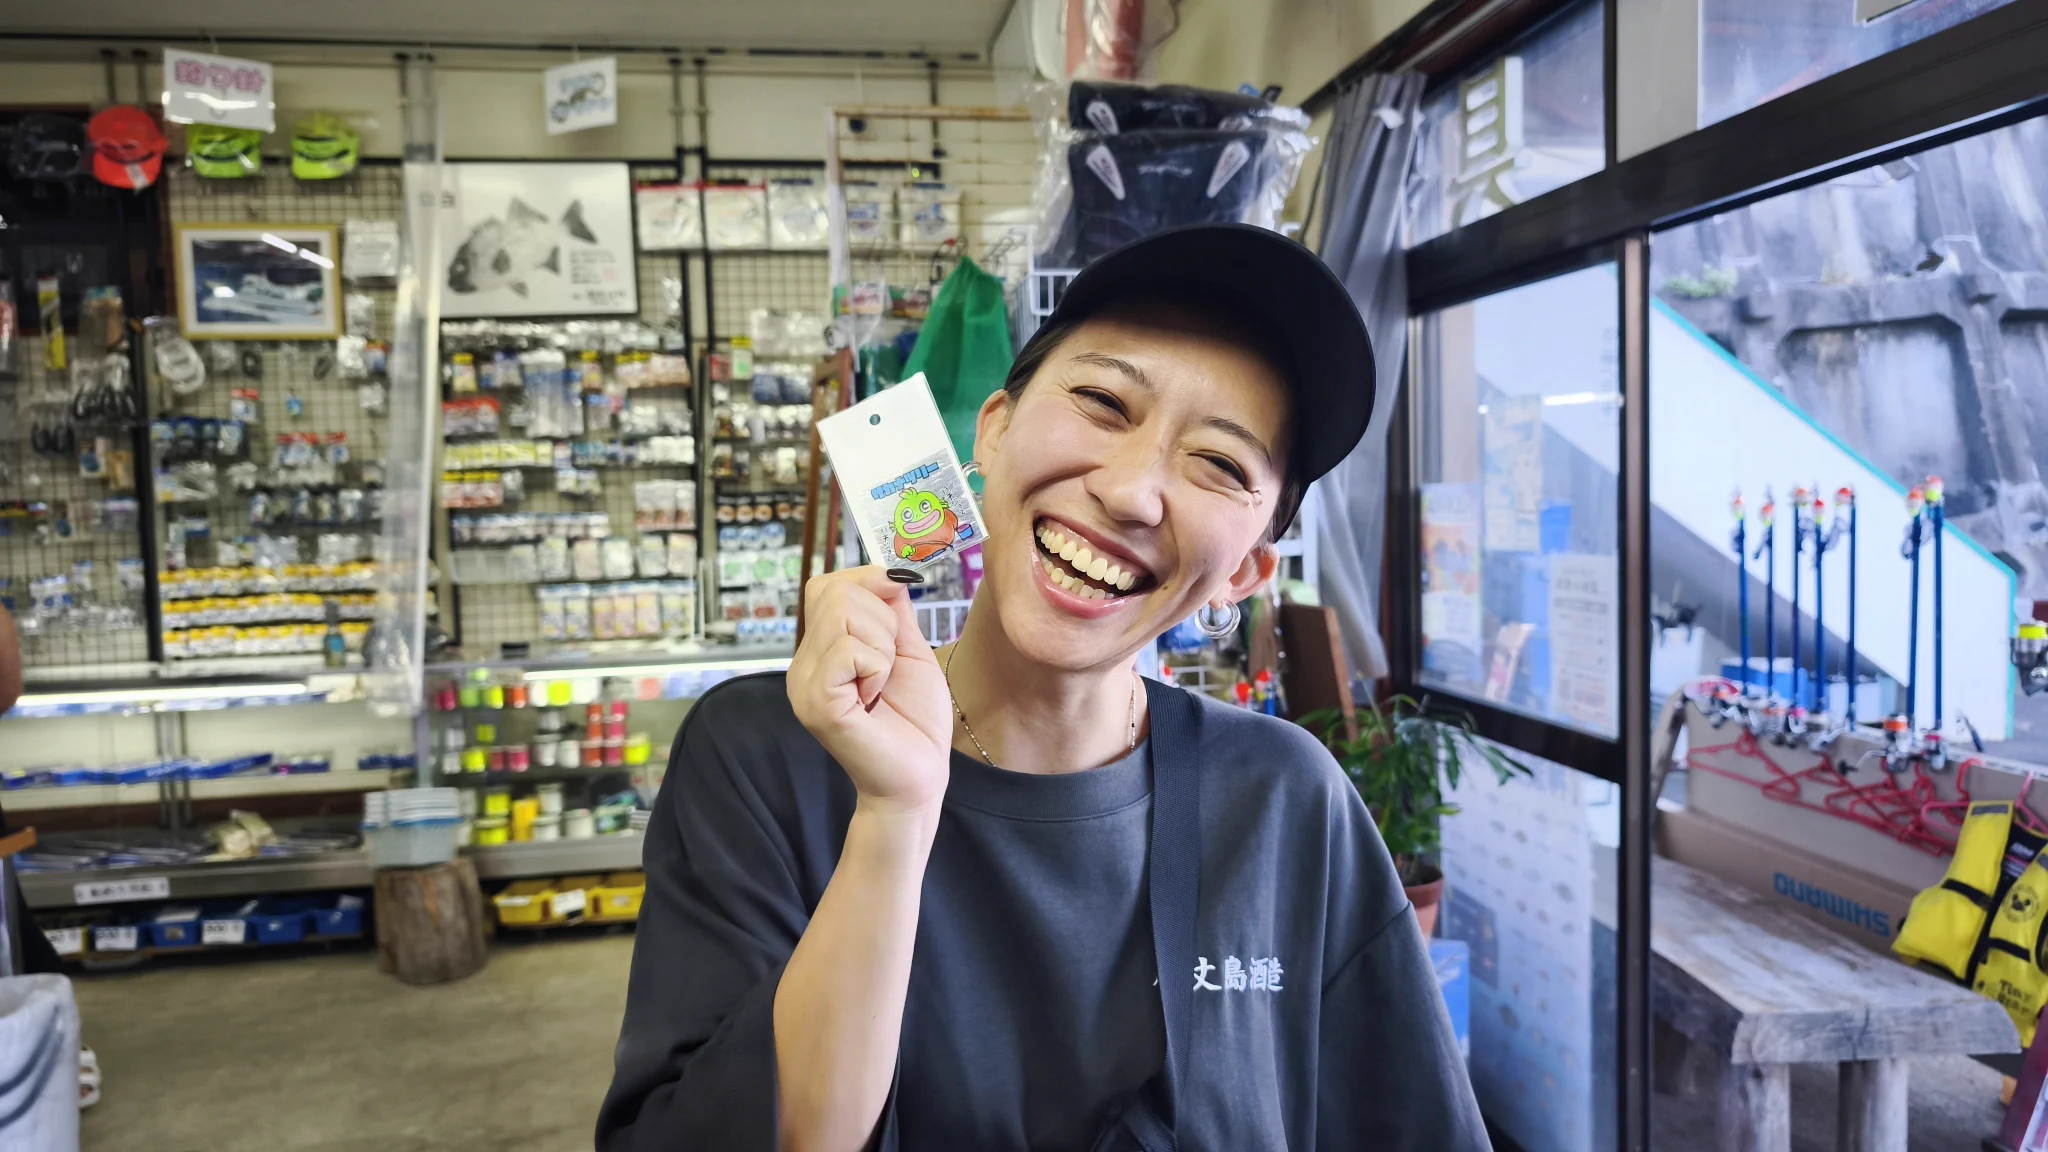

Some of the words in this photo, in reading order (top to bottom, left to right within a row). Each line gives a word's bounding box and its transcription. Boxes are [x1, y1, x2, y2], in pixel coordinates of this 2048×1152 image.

[871, 462, 940, 500] サカナツリー
[1773, 872, 1890, 939] SHIMANO
[1153, 955, 1285, 993] 丈島酒造
